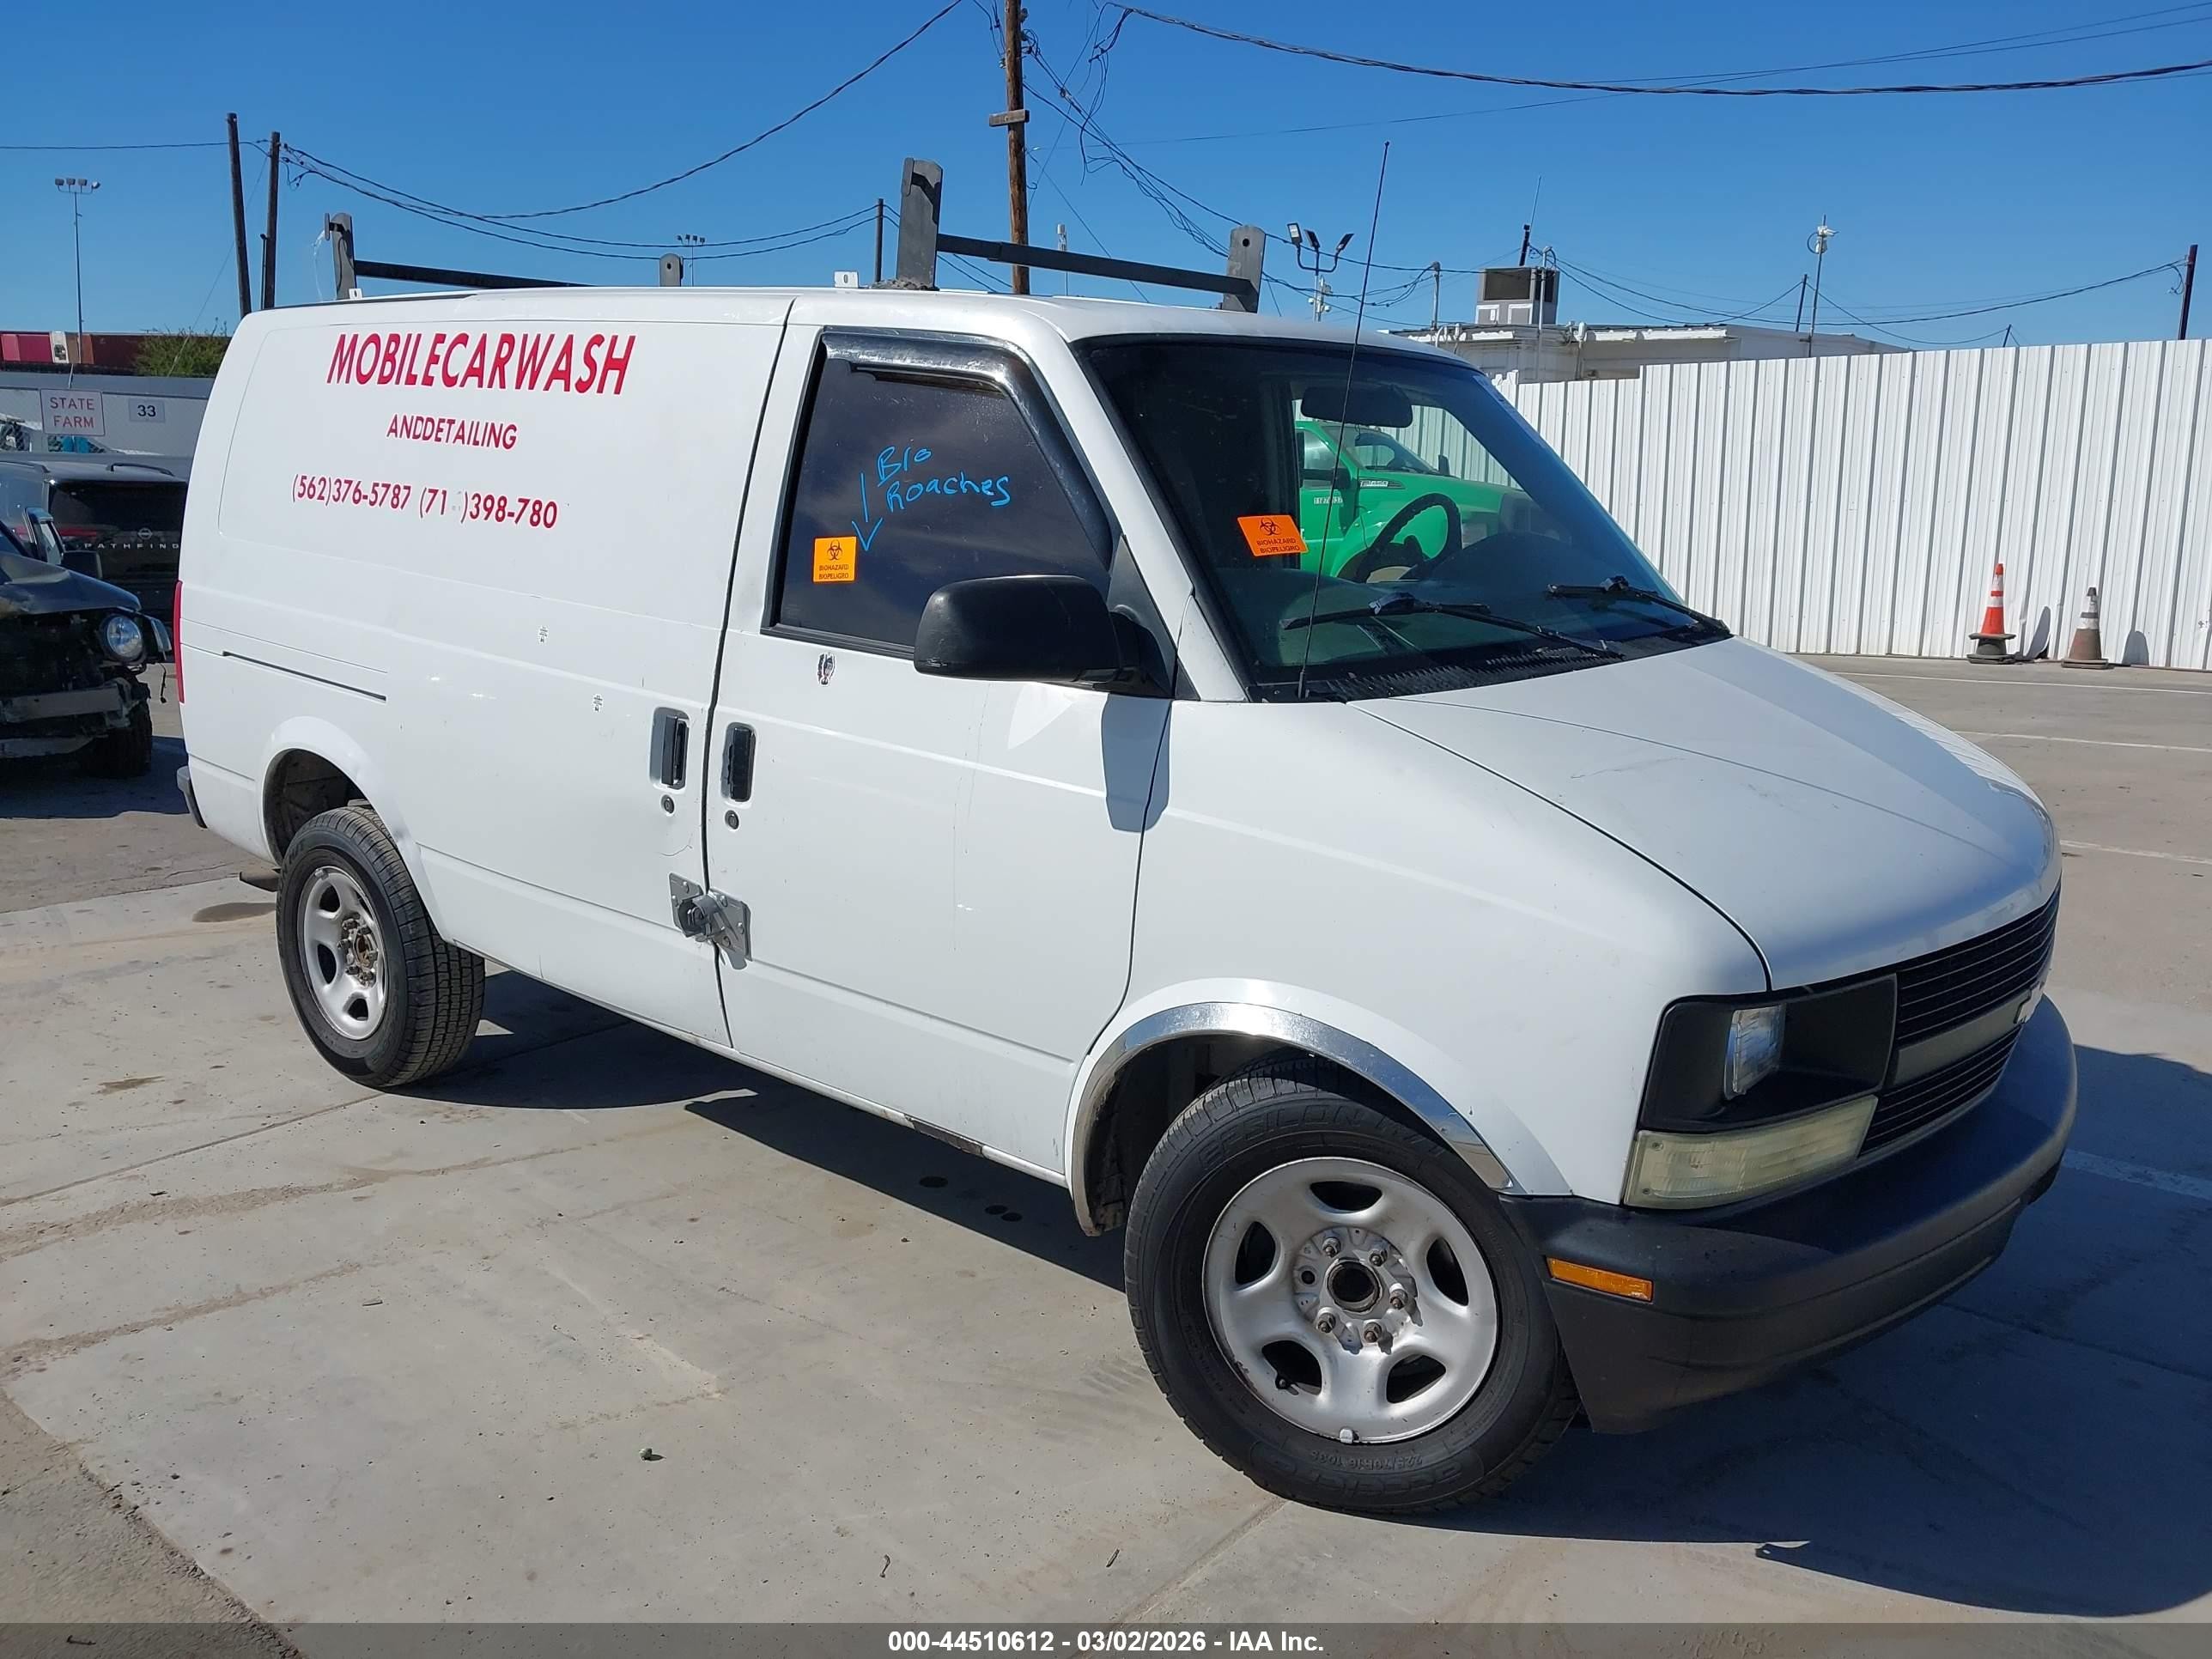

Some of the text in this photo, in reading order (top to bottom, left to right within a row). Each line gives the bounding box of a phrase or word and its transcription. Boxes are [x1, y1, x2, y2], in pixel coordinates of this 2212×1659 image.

[325, 331, 636, 396] MOBILECARWASH
[50, 397, 94, 411] STATE
[137, 404, 156, 417] 33
[53, 416, 94, 428] FARM
[386, 413, 519, 450] ANDDETAILING
[292, 473, 412, 510] (562)376-5787
[885, 471, 1012, 514] Roaches
[1256, 538, 1297, 546] BIOHAZARD
[1260, 545, 1300, 554] BIOPELIGRO
